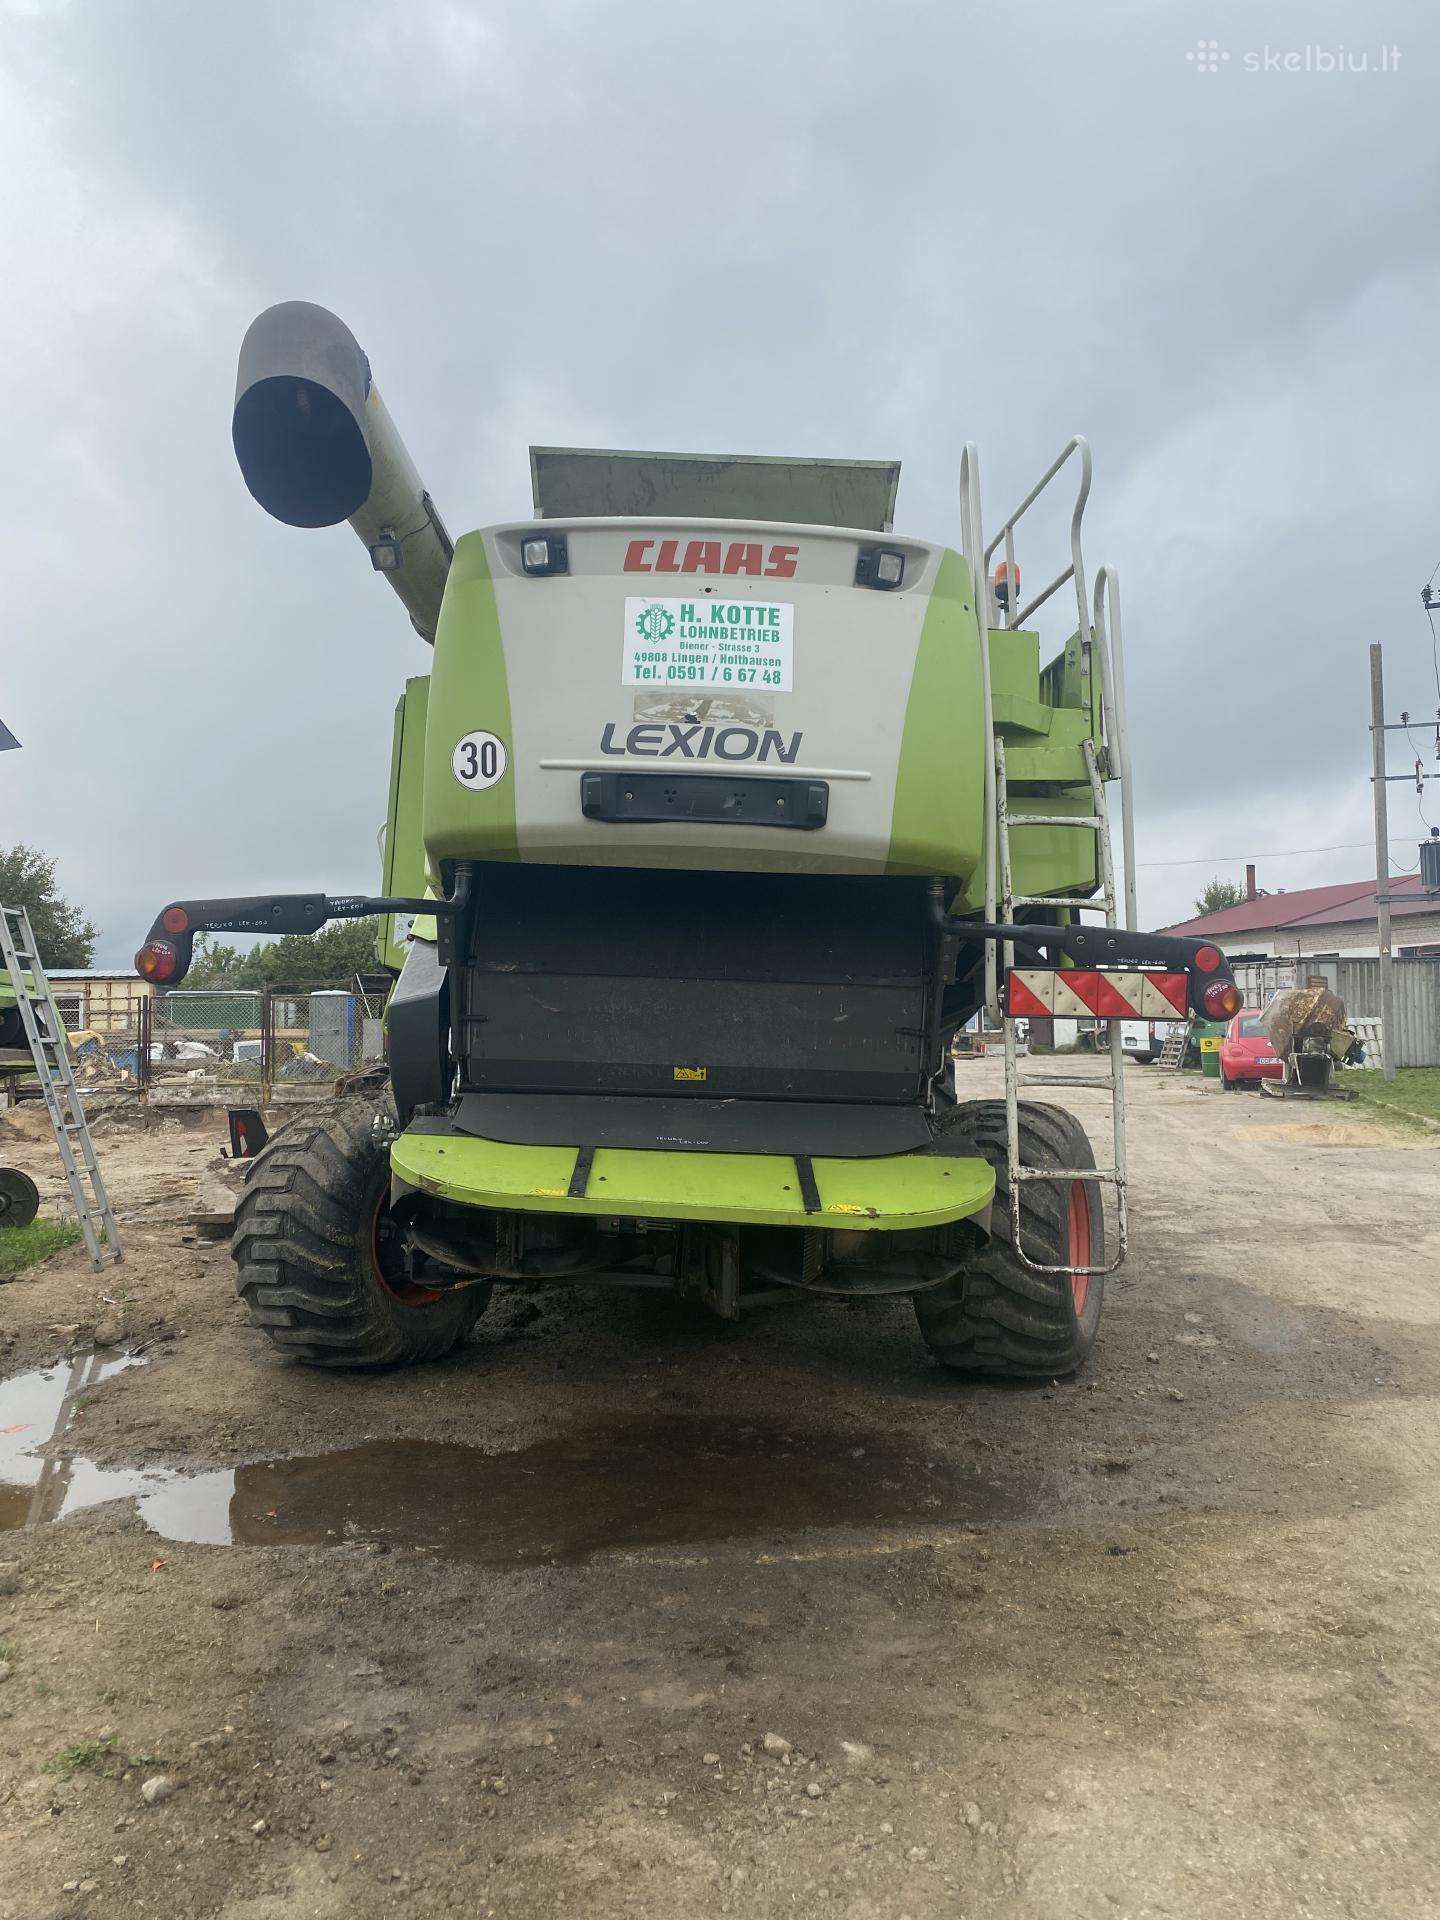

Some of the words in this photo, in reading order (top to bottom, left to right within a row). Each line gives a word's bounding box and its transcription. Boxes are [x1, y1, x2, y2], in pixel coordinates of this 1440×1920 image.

[623, 540, 800, 578] CLAAS
[680, 604, 702, 623] H.
[711, 604, 781, 627] KOTTE
[680, 625, 781, 643] LOHNBETRIEB
[679, 641, 709, 651] Biener
[718, 643, 752, 653] Strasse
[754, 644, 760, 653] 3
[634, 652, 668, 663] 49808
[671, 653, 709, 664] Lingen
[712, 653, 717, 664] /
[719, 654, 782, 667] Holthausen
[634, 665, 662, 680] Tel.
[667, 665, 705, 680] 0591
[711, 667, 719, 682] /
[723, 668, 733, 682] 6
[738, 668, 757, 683] 67
[762, 670, 782, 685] 48
[600, 723, 804, 764] LEXION
[460, 741, 498, 780] 30
